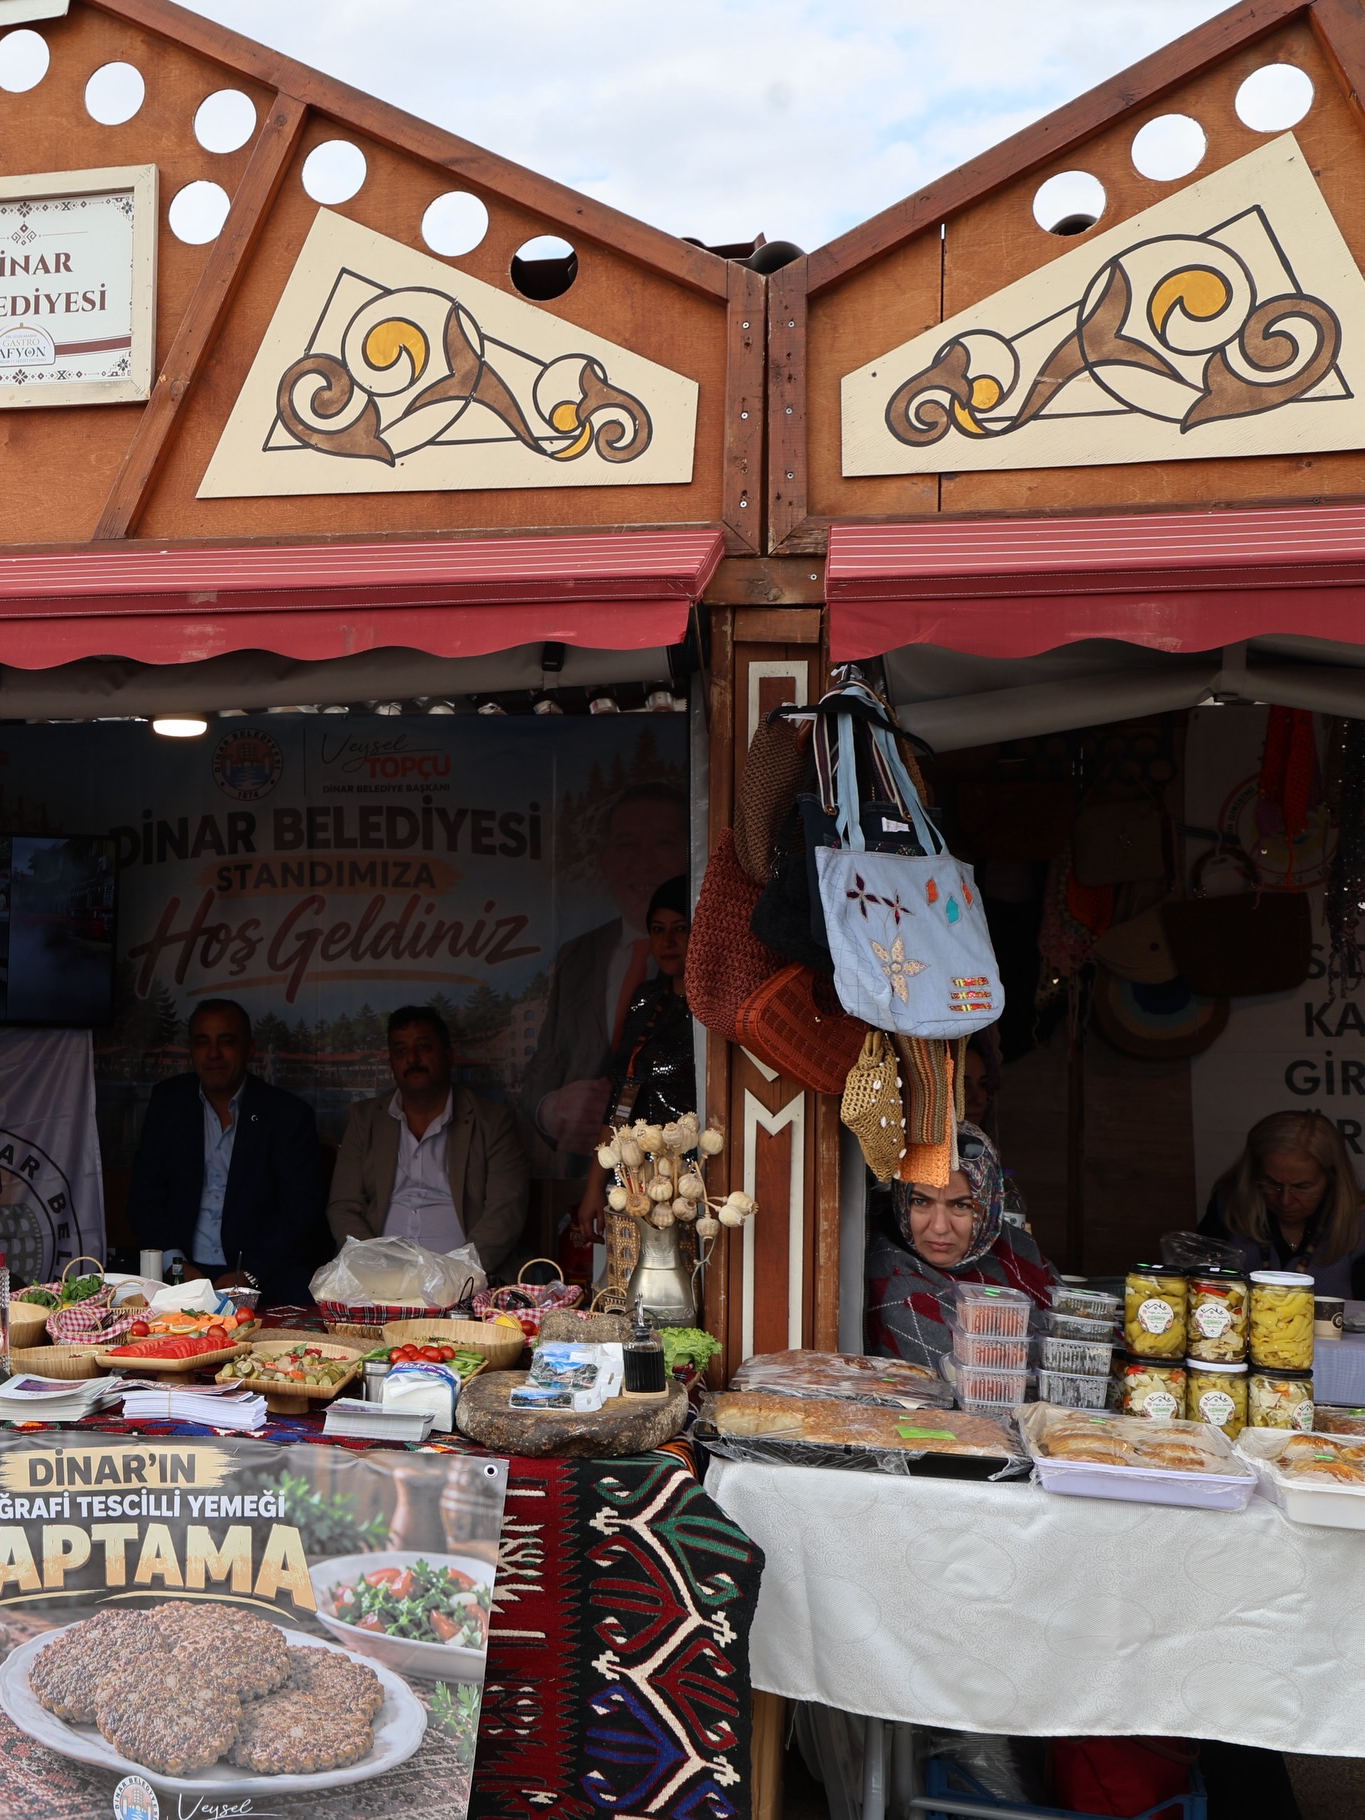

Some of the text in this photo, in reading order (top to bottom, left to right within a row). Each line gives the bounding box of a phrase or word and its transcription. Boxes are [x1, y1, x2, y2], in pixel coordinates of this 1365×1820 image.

[365, 754, 451, 781] TOPÇU
[323, 783, 450, 794] DİNAR BELEDİYE BAŞKANI
[109, 794, 542, 870] DİNAR BELEDİYESİ
[217, 861, 436, 891] STANDIMIZA
[129, 888, 542, 1004] Hoş Geldiniz
[28, 1447, 196, 1487] DİNAR'IN
[76, 1488, 181, 1518] TESCİLLİ
[187, 1489, 285, 1519] YEMEĞİ
